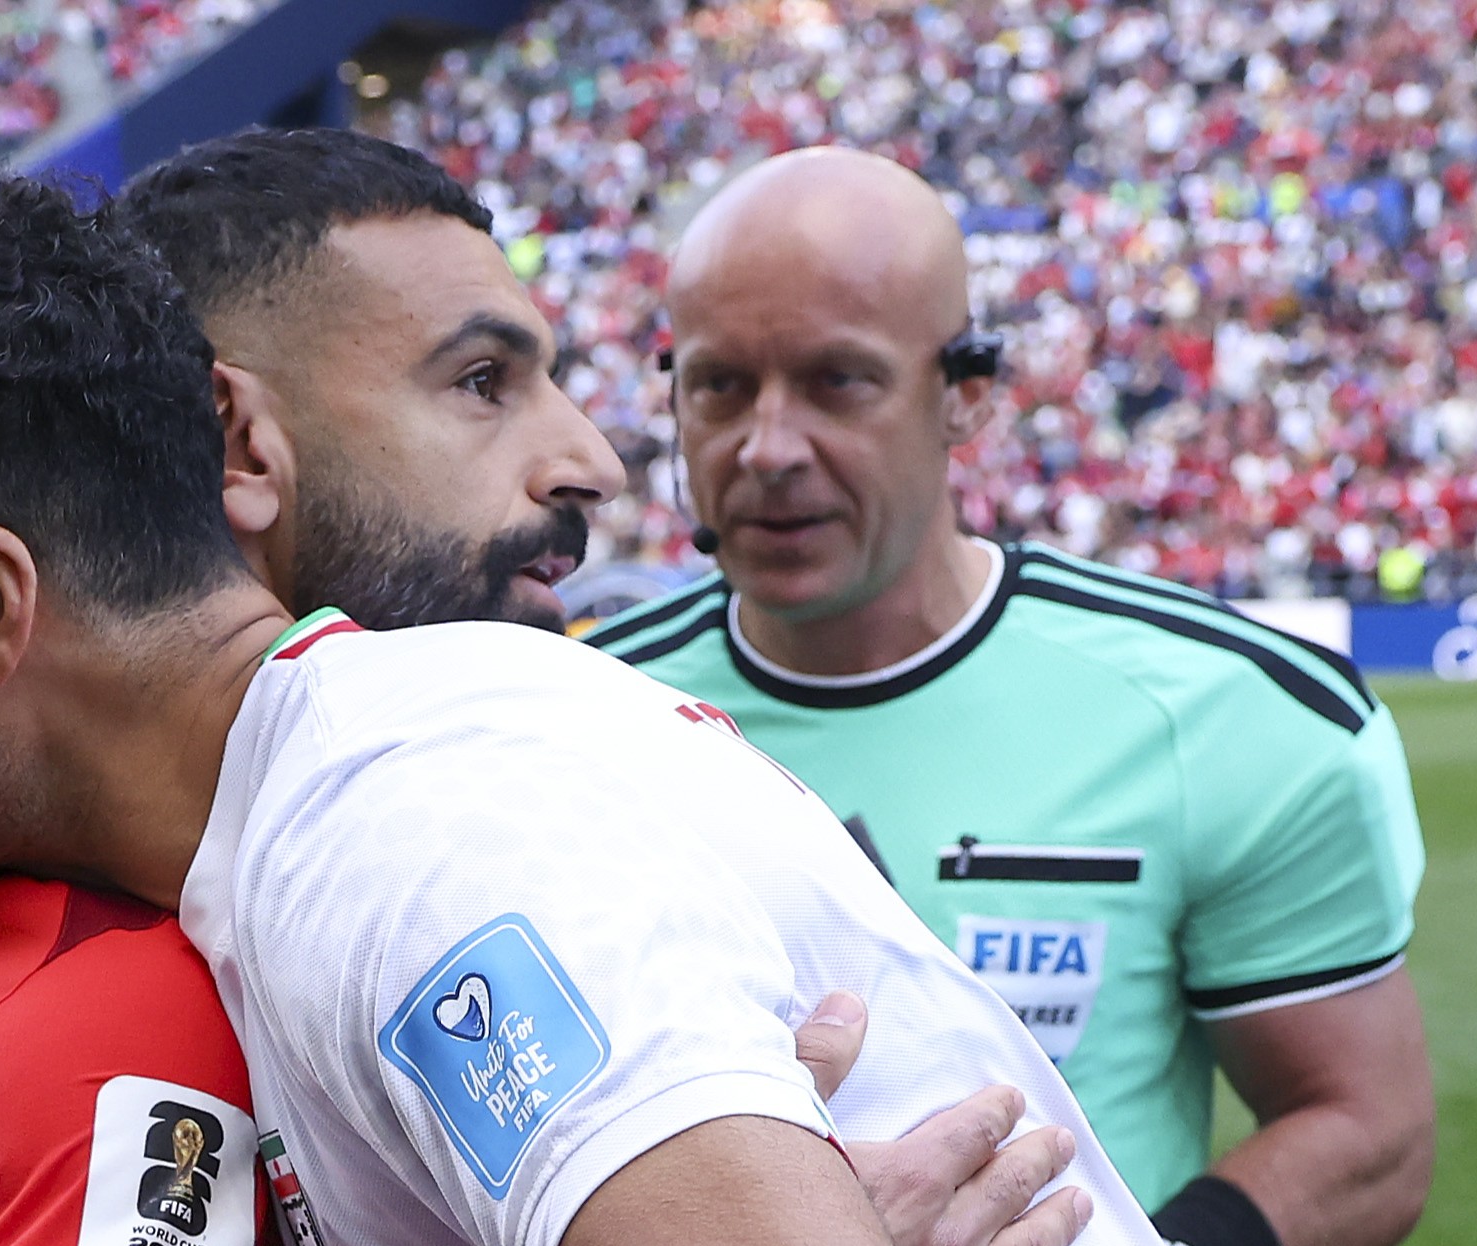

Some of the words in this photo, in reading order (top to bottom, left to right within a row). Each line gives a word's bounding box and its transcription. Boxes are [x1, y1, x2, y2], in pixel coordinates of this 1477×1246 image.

[973, 932, 1088, 976] FIFA
[1013, 1004, 1079, 1025] EREE
[460, 1039, 505, 1103] Unite
[498, 1010, 535, 1053] For
[485, 1041, 557, 1128] PEACE
[513, 1088, 551, 1133] FIFA
[159, 1199, 192, 1224] FIFA
[132, 1225, 178, 1246] WORLD
